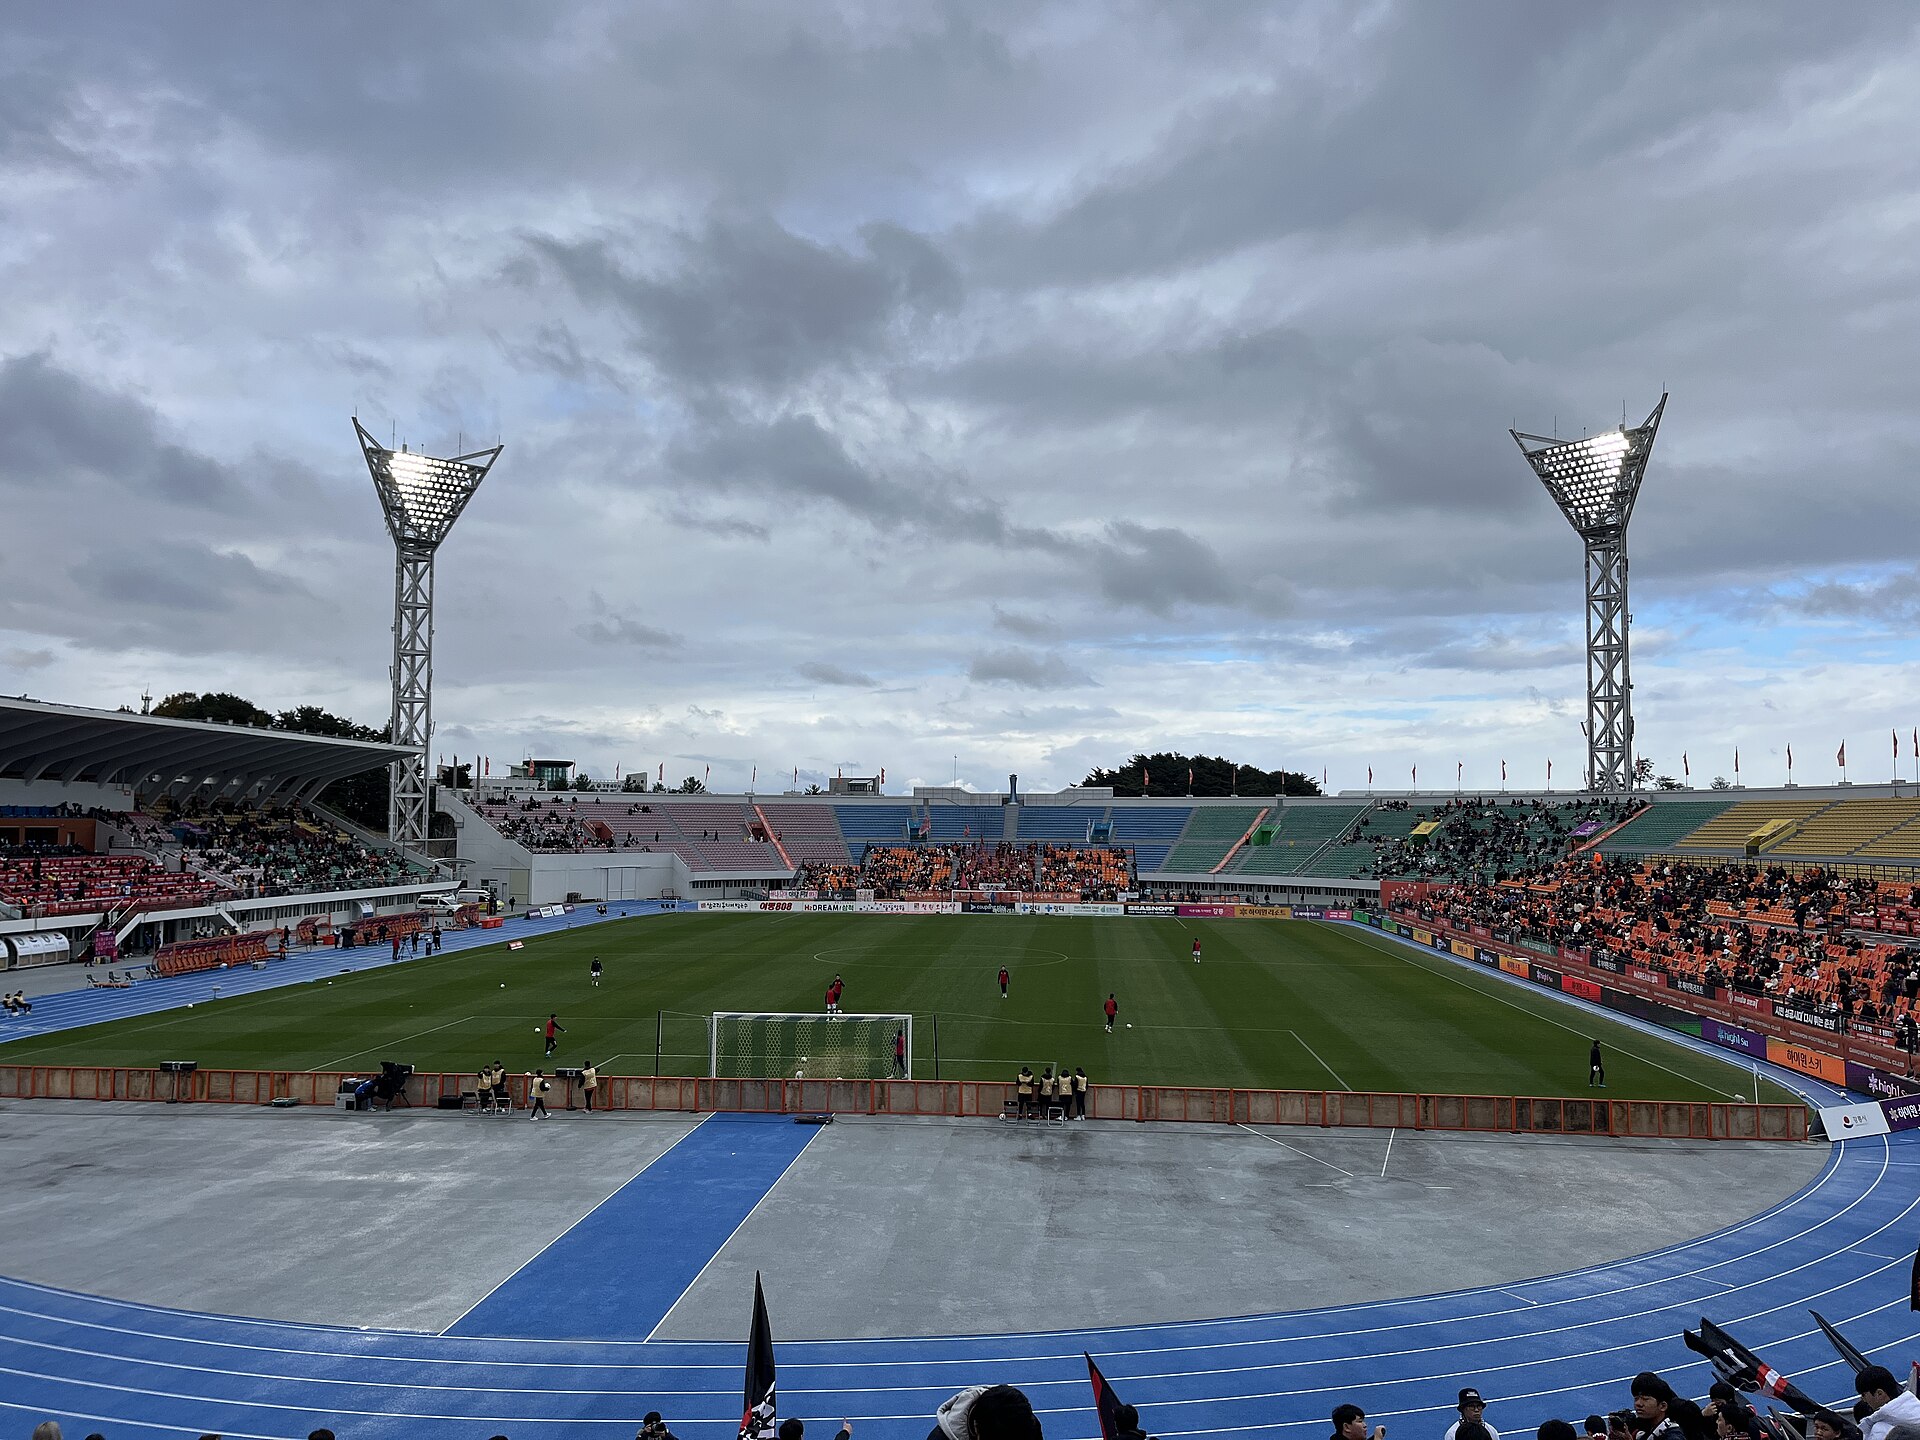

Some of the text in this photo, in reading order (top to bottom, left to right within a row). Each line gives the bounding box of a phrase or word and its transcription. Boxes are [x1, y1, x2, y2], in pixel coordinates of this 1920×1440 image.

[1786, 1049, 1823, 1074] 하이원 스키
[1878, 1078, 1900, 1098] high1
[1897, 1104, 1919, 1120] 하이원
